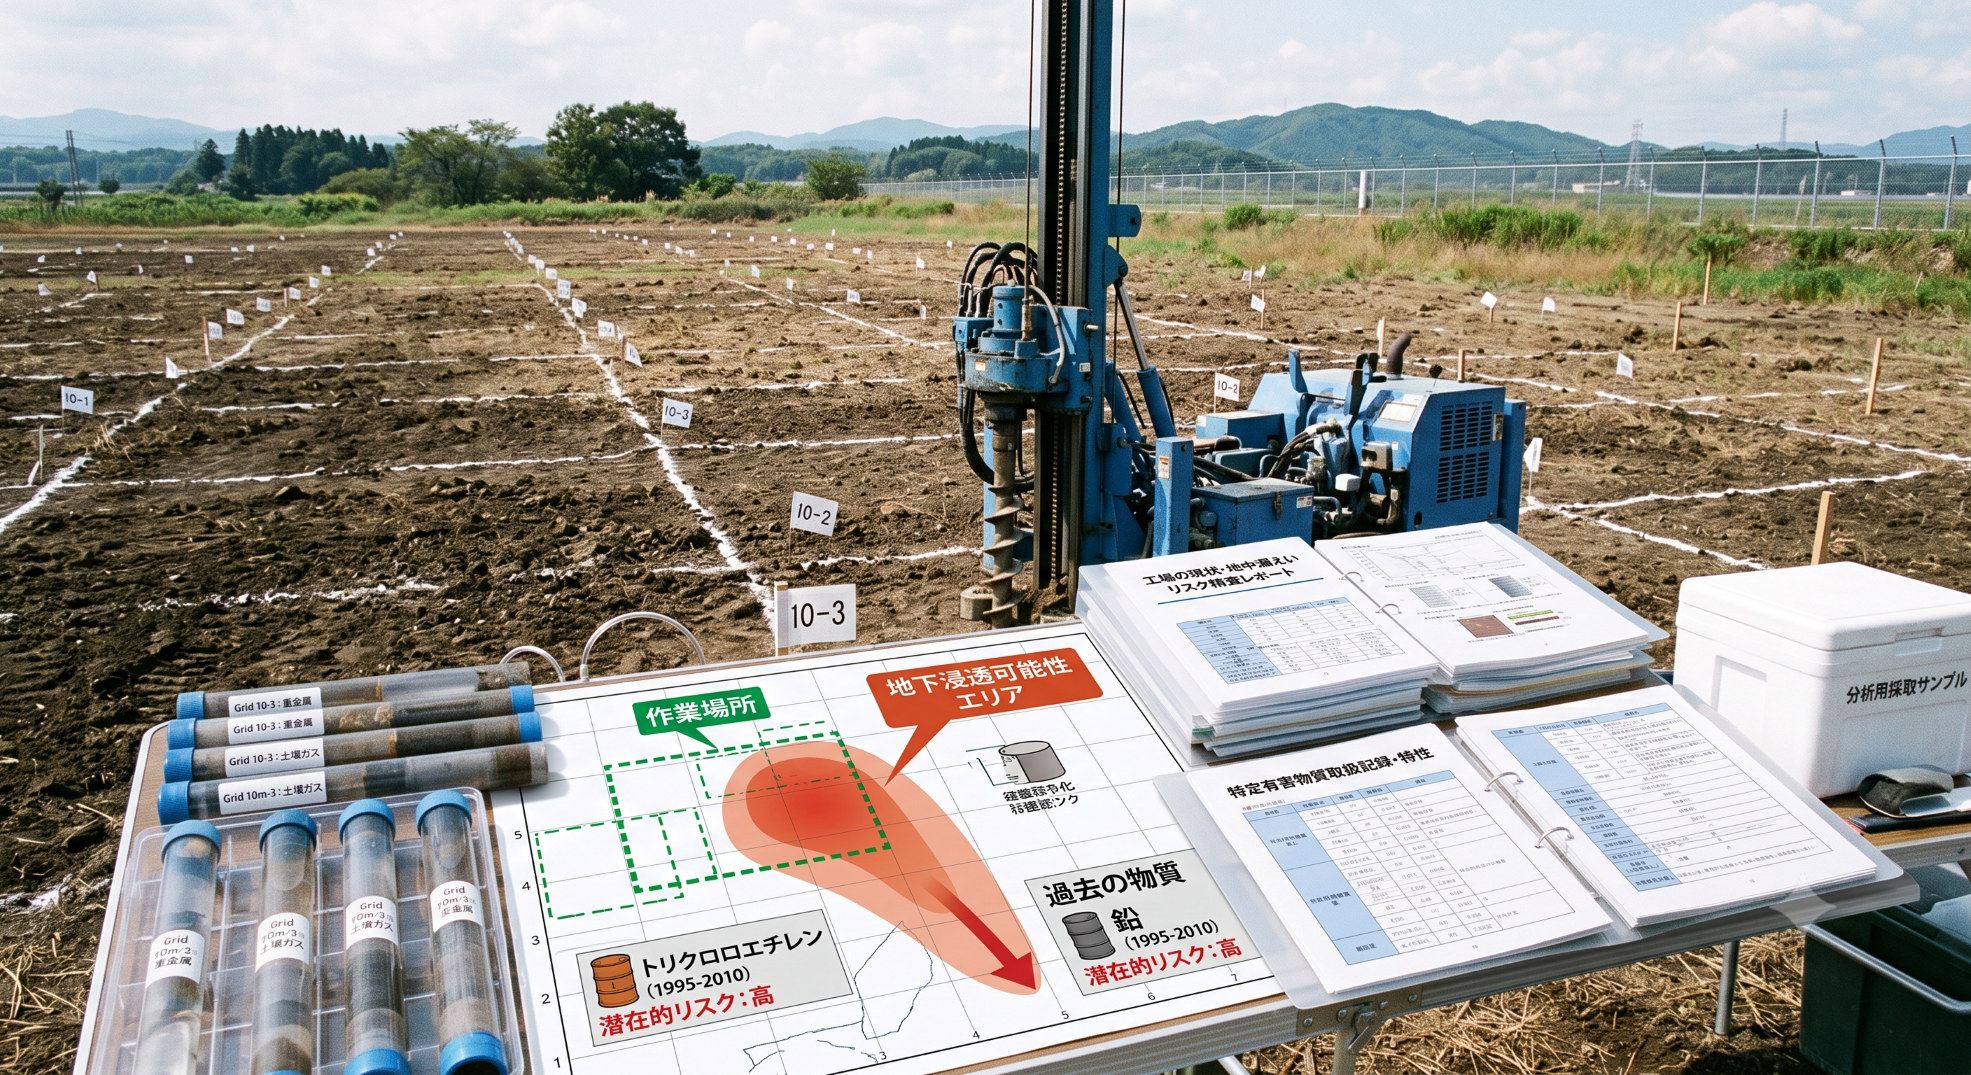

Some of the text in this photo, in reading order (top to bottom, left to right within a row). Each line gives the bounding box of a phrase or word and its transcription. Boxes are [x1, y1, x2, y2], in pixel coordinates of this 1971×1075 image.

[1217, 379, 1238, 394] 10-2
[64, 392, 90, 407] 10-1
[664, 405, 690, 421] 10-3
[796, 502, 832, 526] 10-2
[1167, 568, 1295, 594] リスク精査レポート
[791, 600, 845, 629] 10-3
[886, 655, 1074, 697] 地下浸透可能性
[1845, 670, 1969, 704] 分析用採取サンプル
[956, 685, 1024, 711] エリア
[234, 702, 254, 713] Grid
[646, 694, 758, 728] 作業場所
[233, 724, 254, 734] Grid
[229, 756, 250, 766] Grid
[1226, 746, 1434, 800] 特定有害物質取扱記録・特性
[223, 793, 244, 804] Grid
[514, 830, 523, 840] 5
[522, 881, 532, 892] 4
[1043, 860, 1187, 908] 過去の物質
[443, 886, 466, 896] Grid
[360, 901, 383, 910] Grid
[270, 918, 294, 929] Grid
[1110, 907, 1145, 934] 鉛
[163, 935, 189, 946] Grid
[531, 935, 541, 946] 3
[1124, 918, 1220, 952] (1995-2010)
[642, 927, 824, 979] トリクロロエチレン
[1083, 936, 1243, 986] 潜在的リスク：高
[647, 966, 752, 1000] (1995-2010)
[1231, 974, 1239, 983] 7
[541, 993, 551, 1005] 2
[1147, 991, 1156, 1002] 6
[598, 985, 776, 1038] 潜在的リスク：高
[1061, 1010, 1070, 1020] 5
[972, 1031, 981, 1041] 4
[879, 1050, 887, 1061] 3
[553, 1057, 561, 1069] 1
